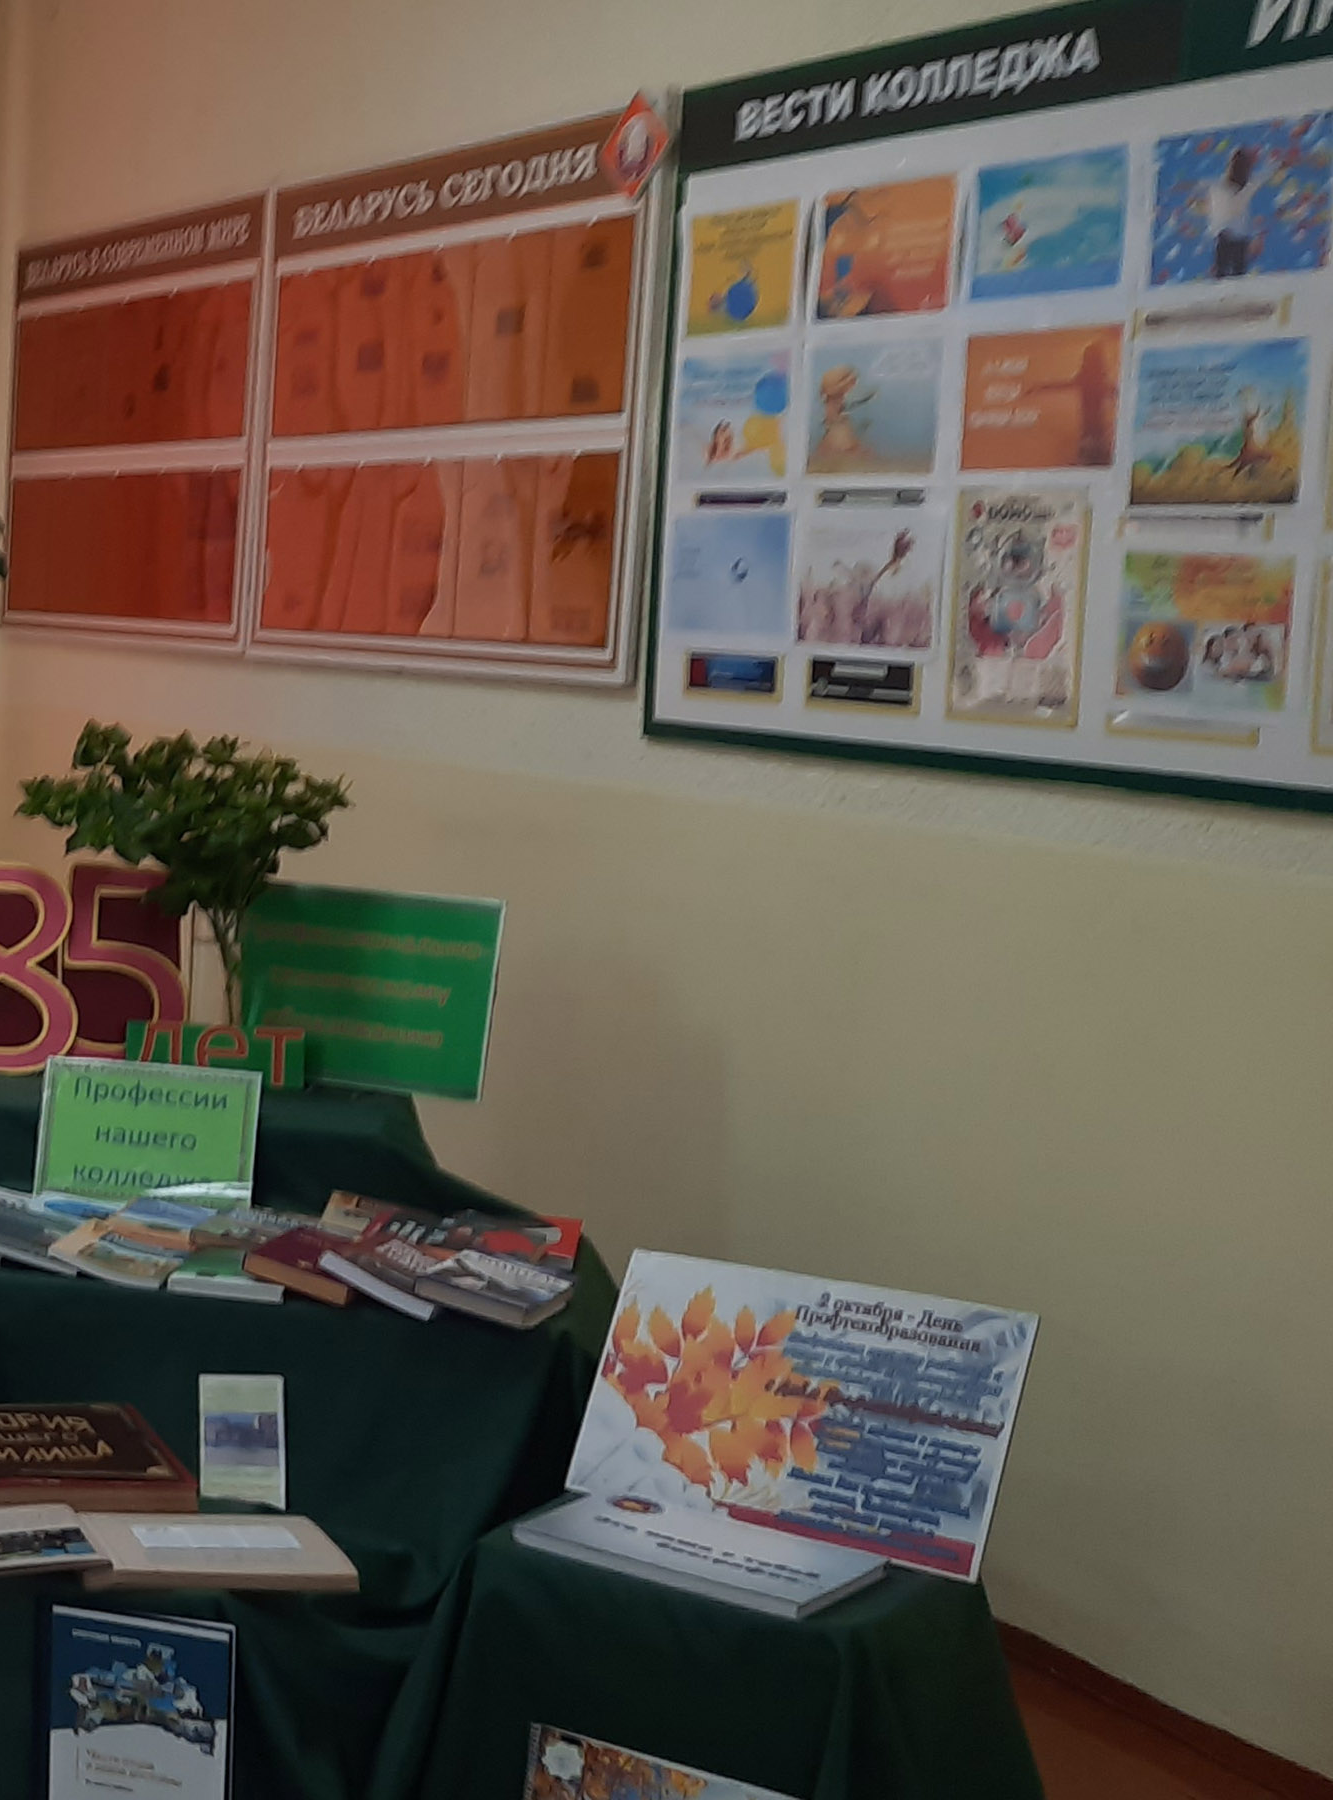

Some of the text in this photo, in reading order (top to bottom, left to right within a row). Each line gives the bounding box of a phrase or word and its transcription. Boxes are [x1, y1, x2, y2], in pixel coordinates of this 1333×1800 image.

[1245, 0, 1333, 49] И
[734, 27, 1102, 142] ВЕСТИ КОЛЛЕДЖА
[293, 142, 599, 240] БЕЛАРУСЬ СЕГОДНЯ
[138, 1021, 306, 1088] лет
[74, 1075, 229, 1110] Профессии
[95, 1125, 198, 1152] нашего
[832, 1298, 904, 1323] октября
[916, 1309, 965, 1335] День
